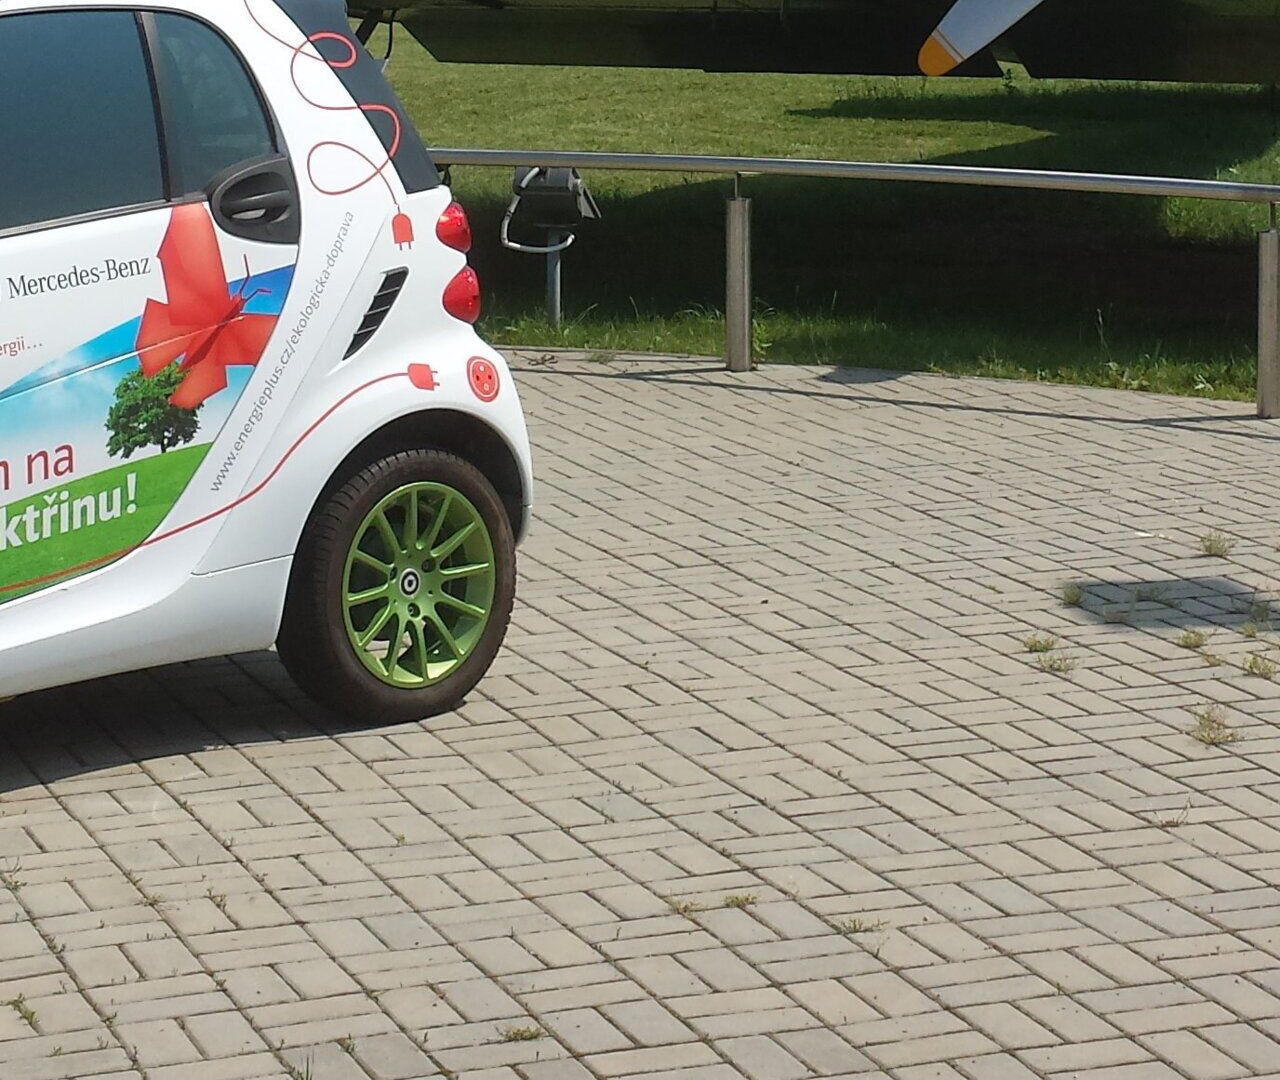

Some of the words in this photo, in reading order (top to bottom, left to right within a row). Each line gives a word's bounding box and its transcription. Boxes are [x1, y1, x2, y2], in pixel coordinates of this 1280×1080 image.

[7, 256, 152, 299] Mercedes-Benz
[211, 210, 354, 492] www.energieplus.cz/ekologicka-doprava
[27, 443, 75, 485] na
